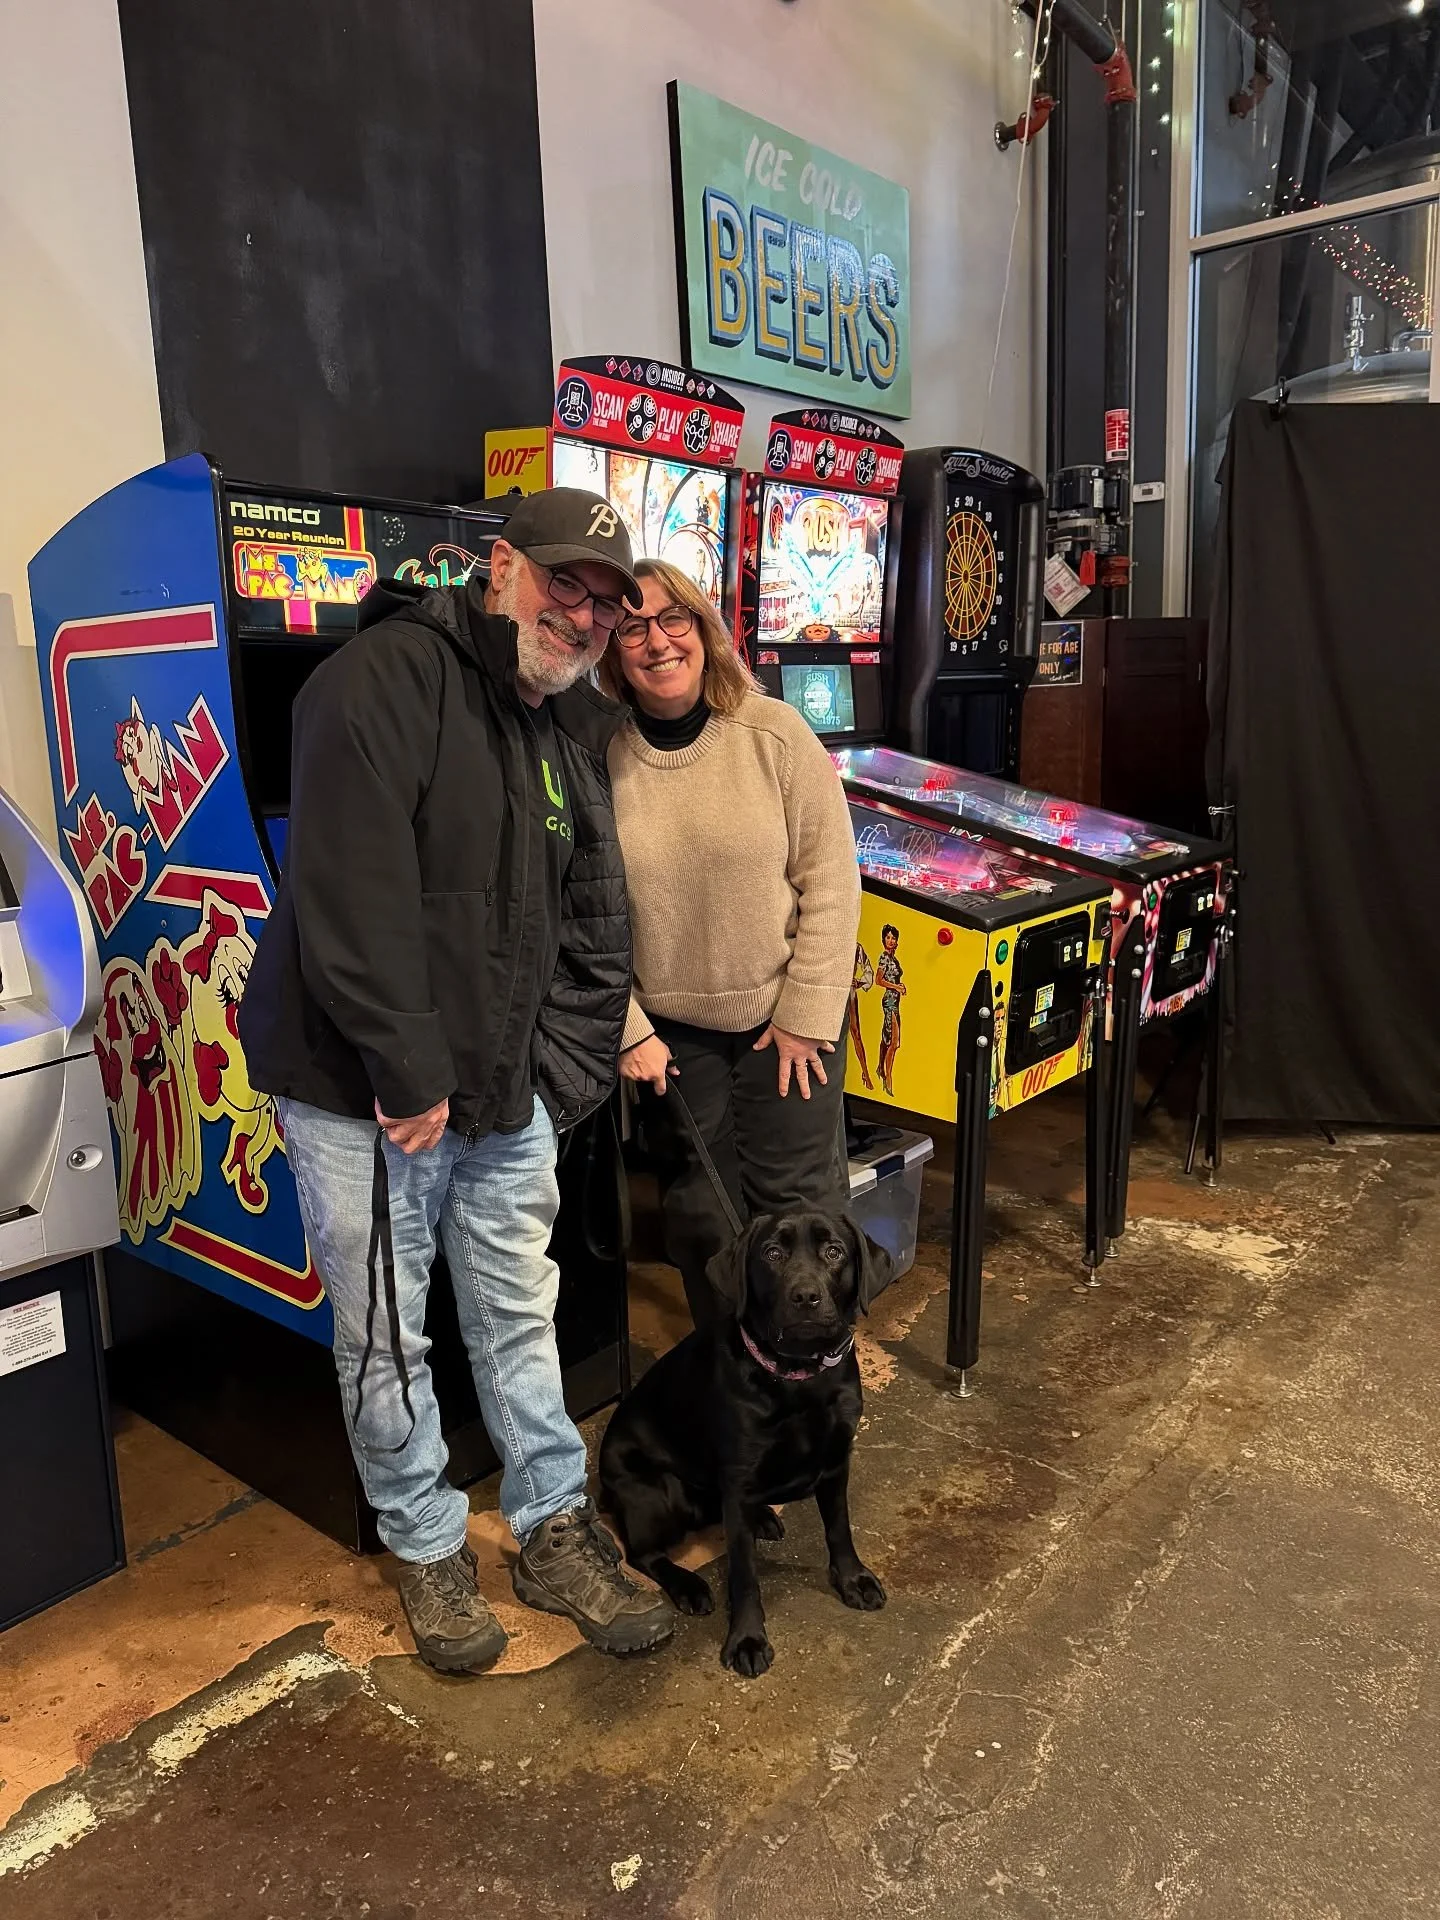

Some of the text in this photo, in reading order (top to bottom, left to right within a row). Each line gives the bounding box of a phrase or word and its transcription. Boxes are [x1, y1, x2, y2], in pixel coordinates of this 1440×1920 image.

[744, 133, 862, 222] ICE COLD
[702, 185, 900, 390] BEERS
[660, 367, 686, 387] INSIDER
[593, 391, 625, 421] SCAN
[658, 407, 684, 435] PLAY
[711, 420, 741, 448] SHARE
[488, 447, 545, 477] 007
[792, 440, 814, 464] SCAN
[835, 449, 856, 471] PLAY
[876, 456, 902, 480] SHARE
[954, 497, 960, 508] 5
[965, 496, 974, 507] 20
[978, 501, 982, 511] 1
[230, 502, 320, 526] namco
[585, 503, 619, 539] B
[233, 525, 345, 546] 20 Year Reunion
[993, 531, 998, 541] 4
[998, 573, 1003, 583] 6
[990, 616, 997, 625] 15
[950, 641, 958, 652] 19
[972, 641, 979, 651] 17
[982, 631, 988, 641] 2
[1048, 643, 1062, 655] FOR
[1064, 641, 1079, 655] AGE
[1040, 661, 1060, 675] ONLY
[1021, 1053, 1066, 1100] 007
